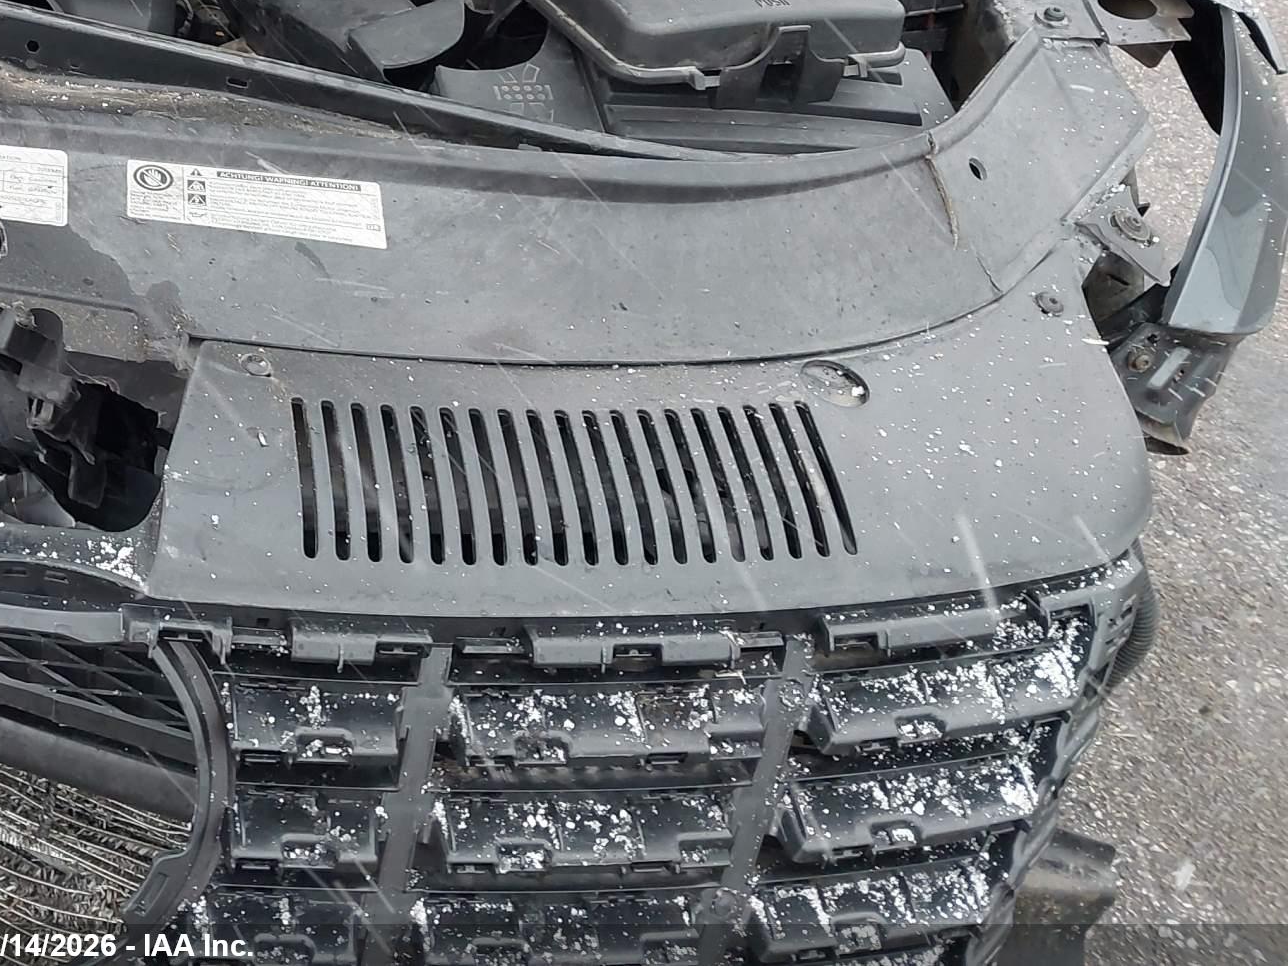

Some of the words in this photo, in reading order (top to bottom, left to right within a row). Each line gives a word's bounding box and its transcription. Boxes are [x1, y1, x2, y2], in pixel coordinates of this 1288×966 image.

[219, 172, 263, 181] ACHTUNG!
[265, 175, 309, 185] WARNING!
[311, 181, 359, 190] ATTENTION!
